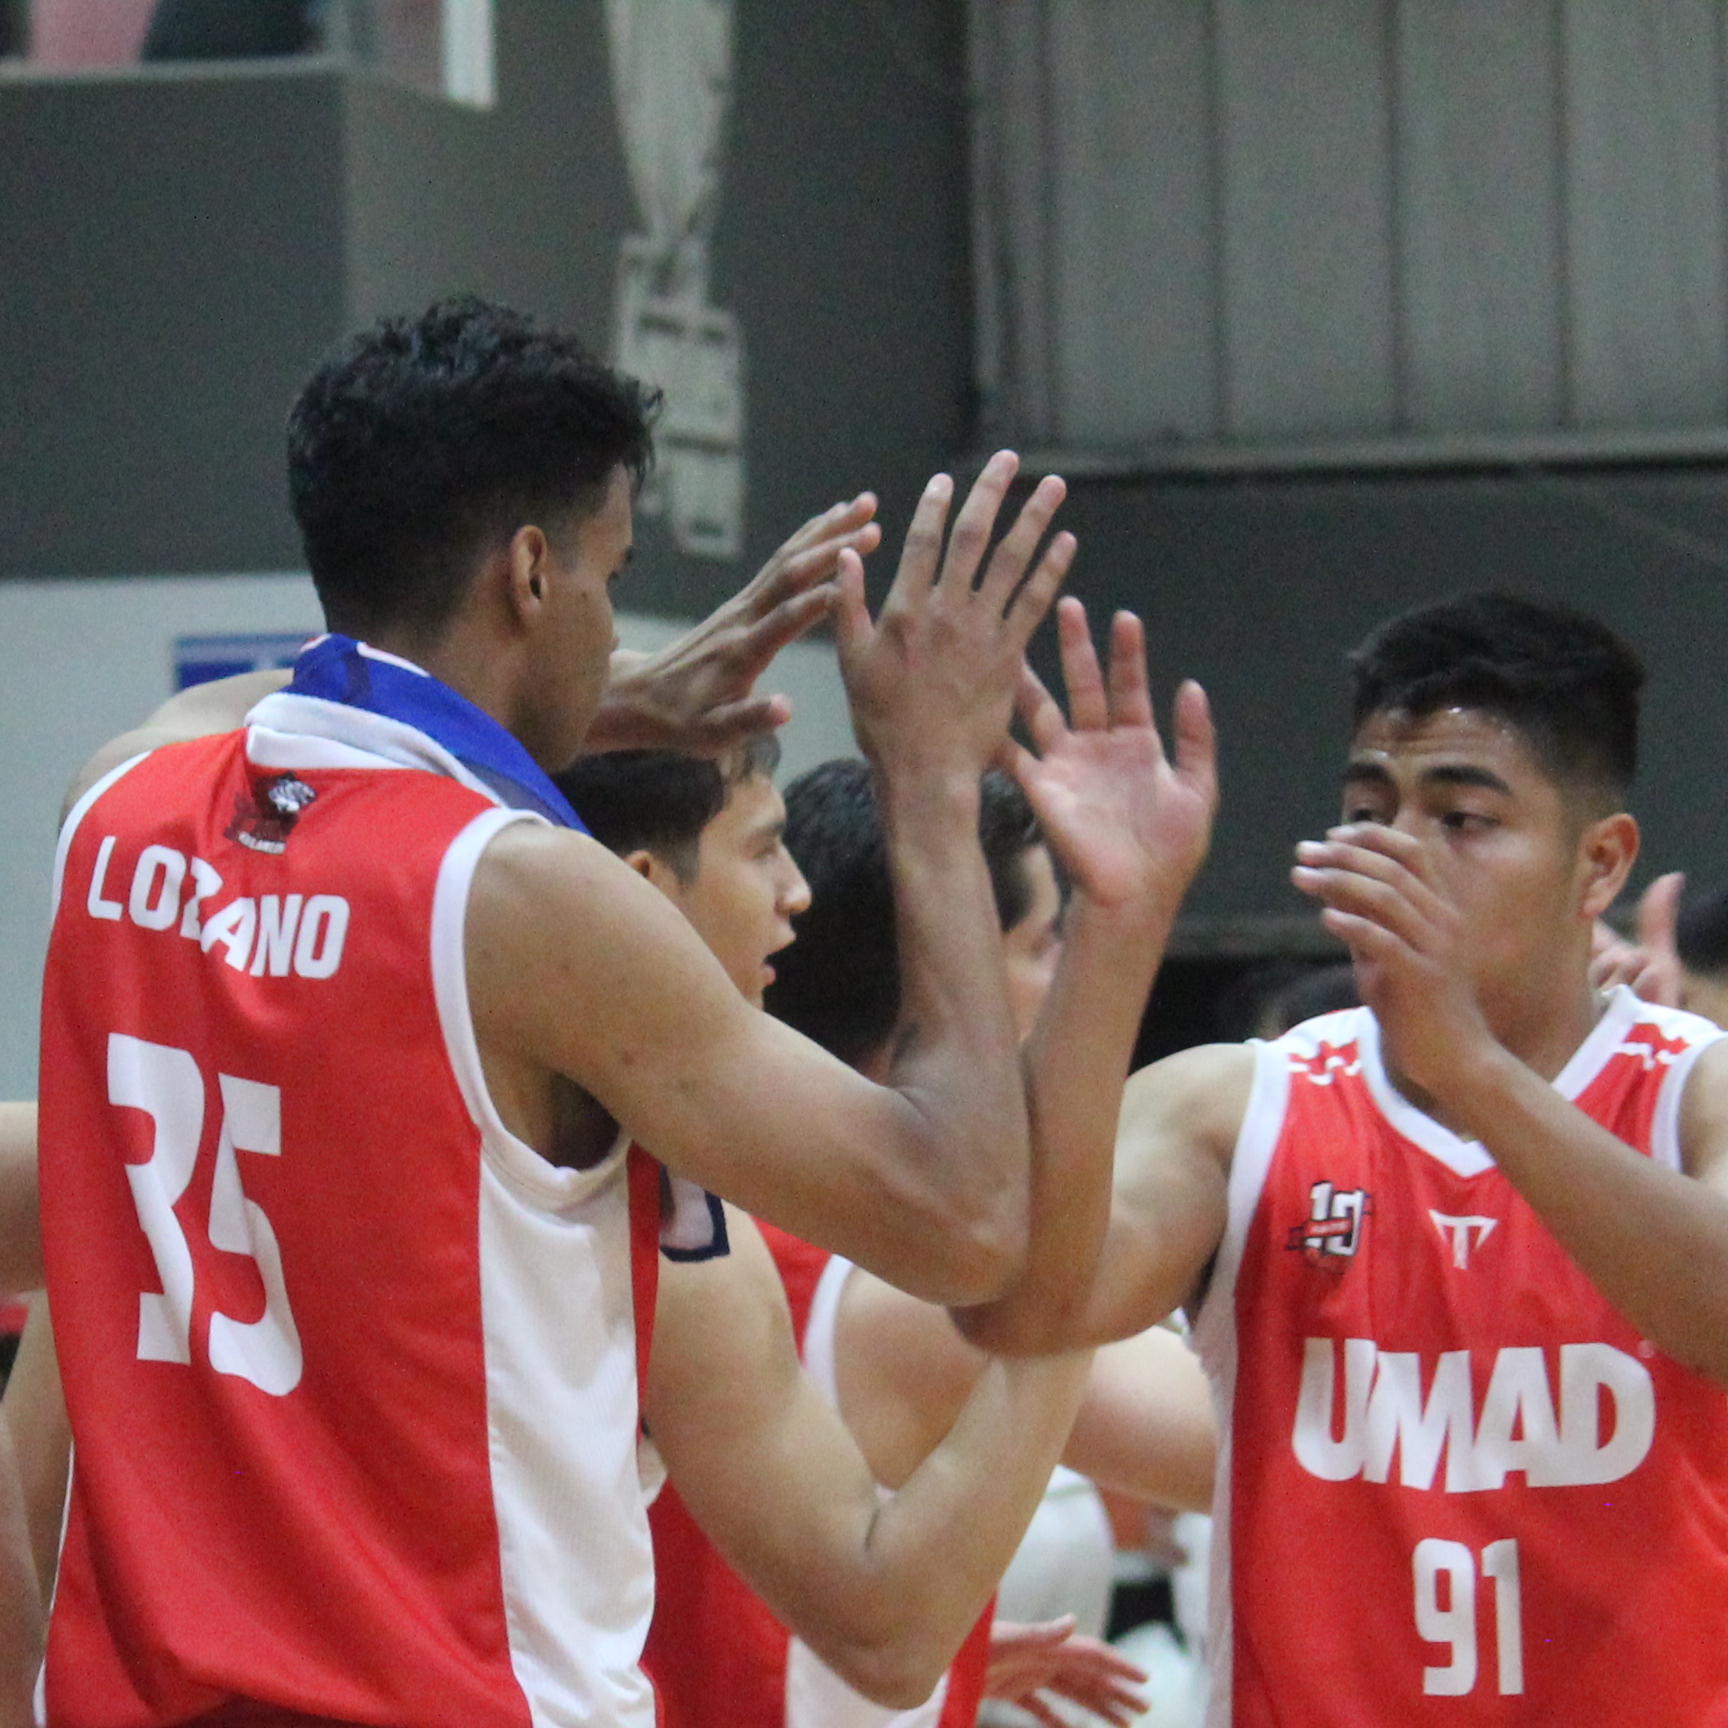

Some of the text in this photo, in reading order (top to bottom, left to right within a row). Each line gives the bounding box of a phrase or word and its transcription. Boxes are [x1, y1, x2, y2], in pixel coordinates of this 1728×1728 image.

[87, 833, 351, 980] LOZANO
[106, 1033, 304, 1397] 35
[1291, 1337, 1656, 1494] UMAD
[1413, 1536, 1524, 1698] 91
